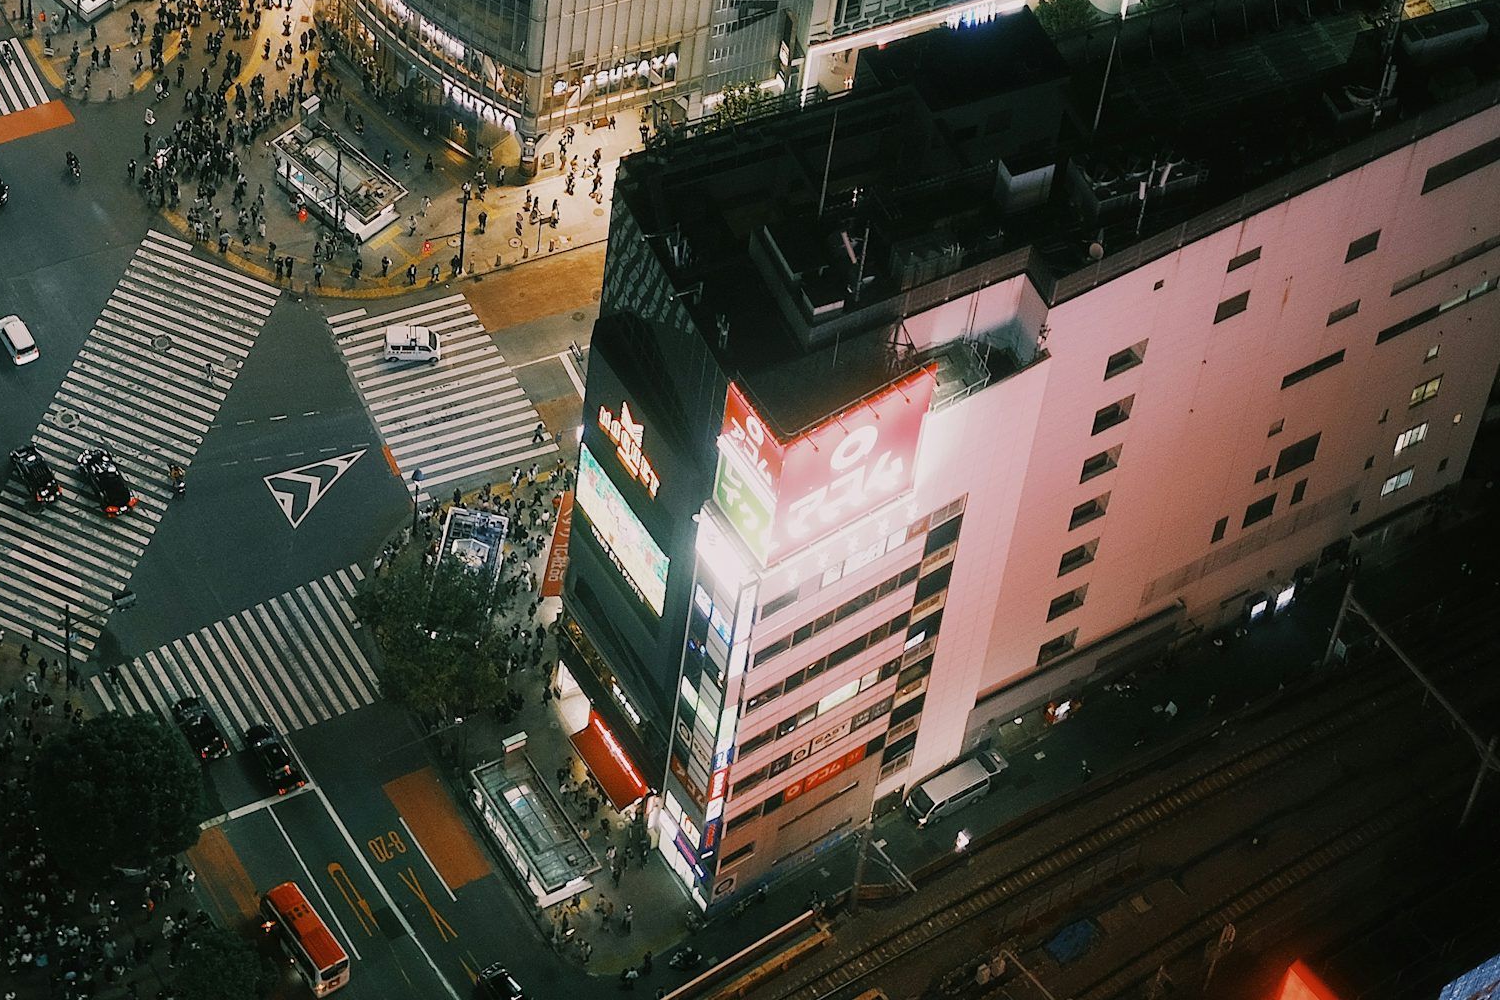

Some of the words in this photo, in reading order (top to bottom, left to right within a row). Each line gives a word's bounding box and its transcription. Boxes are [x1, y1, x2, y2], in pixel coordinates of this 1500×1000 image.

[582, 52, 678, 86] TSUTAYA
[442, 78, 518, 135] TSUTAYA
[368, 830, 407, 863] 8-20
